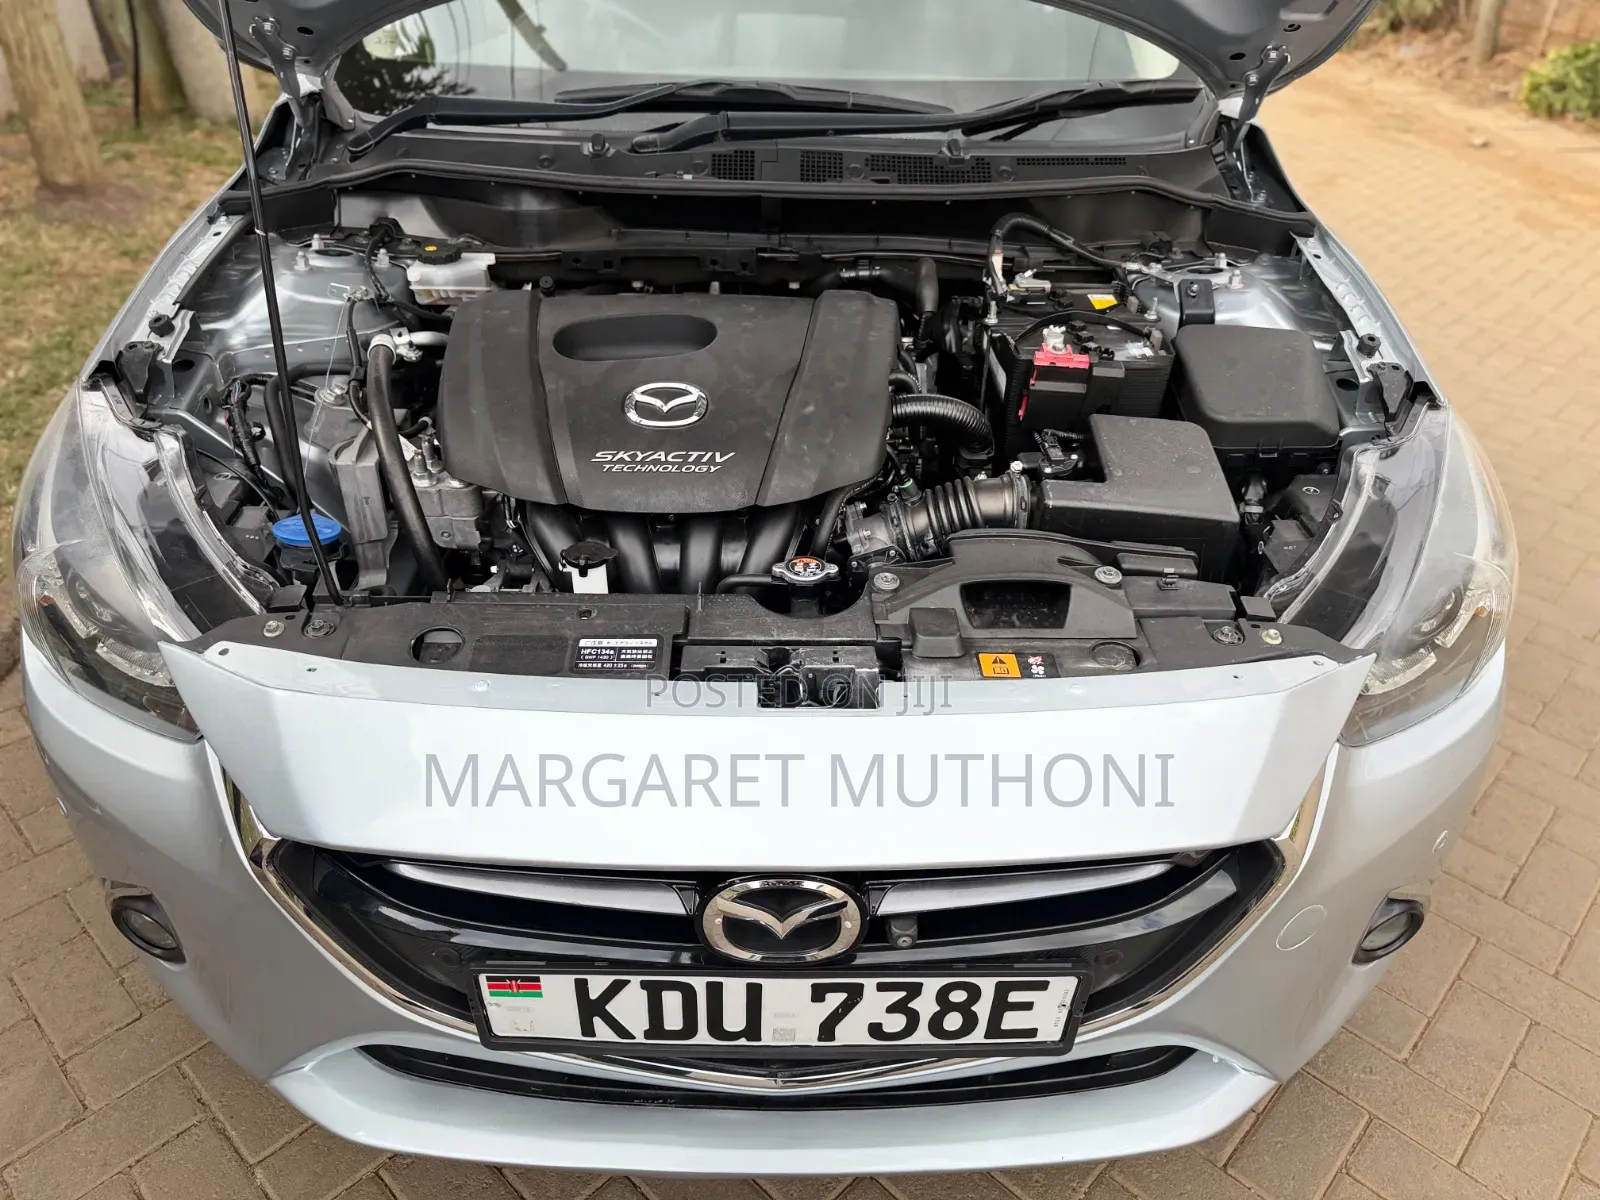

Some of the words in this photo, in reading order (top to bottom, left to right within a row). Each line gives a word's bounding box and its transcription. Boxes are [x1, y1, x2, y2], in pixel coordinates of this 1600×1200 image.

[591, 451, 736, 462] SKYACTIV
[602, 464, 722, 473] TECHNOLOGY
[573, 977, 763, 1042] KDU
[811, 979, 1051, 1043] 738E
